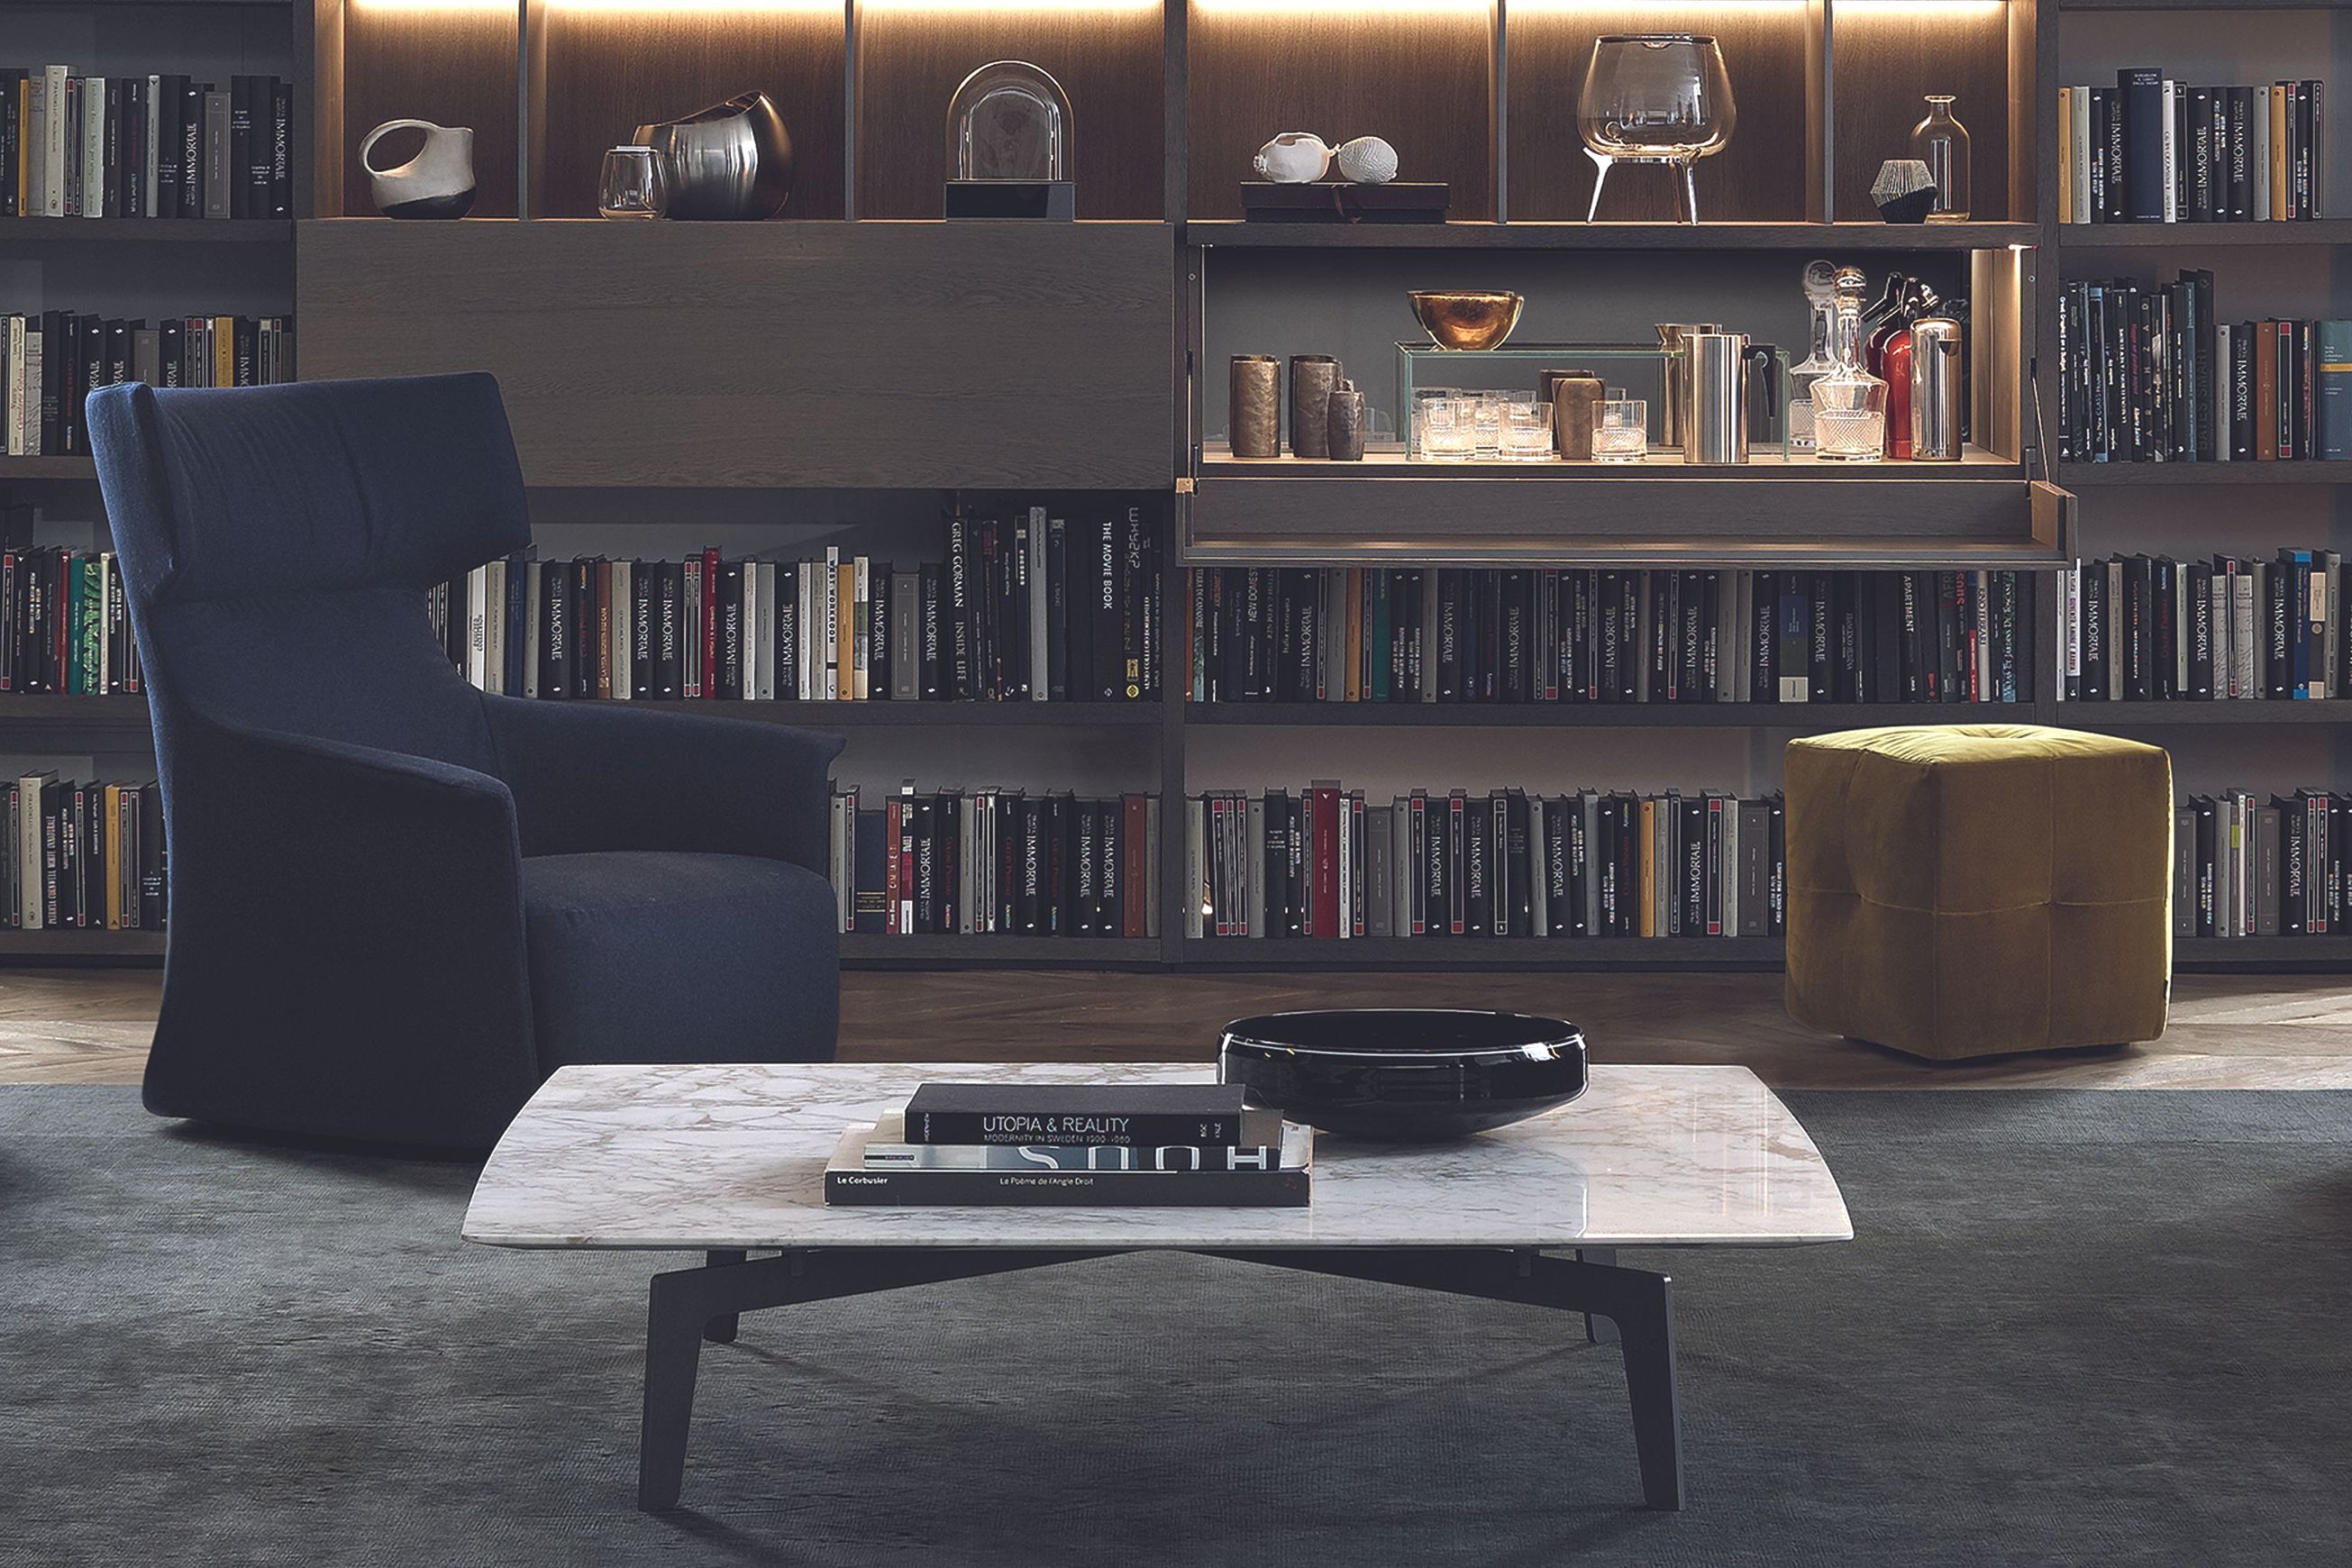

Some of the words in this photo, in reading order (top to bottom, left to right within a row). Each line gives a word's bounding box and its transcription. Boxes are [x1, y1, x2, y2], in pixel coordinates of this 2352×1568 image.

[952, 523, 961, 552] GREG
[1102, 522, 1112, 541] THE
[828, 559, 836, 586] WEST
[1102, 544, 1113, 577] MOVIE
[953, 556, 964, 606] GORMAN
[1103, 579, 1114, 609] BOOK
[828, 588, 836, 644] WORKROOM
[1248, 603, 1257, 622] NEW
[1903, 575, 1914, 633] APARTMENT
[927, 599, 936, 661] IMMORTALE
[955, 622, 965, 655] INSIDE
[957, 659, 967, 681] LIFE
[984, 1117, 1040, 1133] UTOPIA
[1046, 1117, 1058, 1133] &
[1063, 1117, 1130, 1133] REALITY
[984, 1135, 1033, 1144] MODERNITY
[1035, 1135, 1044, 1144] IN
[1047, 1135, 1082, 1144] SWEDEN
[1000, 1177, 1008, 1185] Le
[1010, 1177, 1035, 1185] Poème
[1038, 1177, 1047, 1185] de
[1075, 1177, 1094, 1185] Droit
